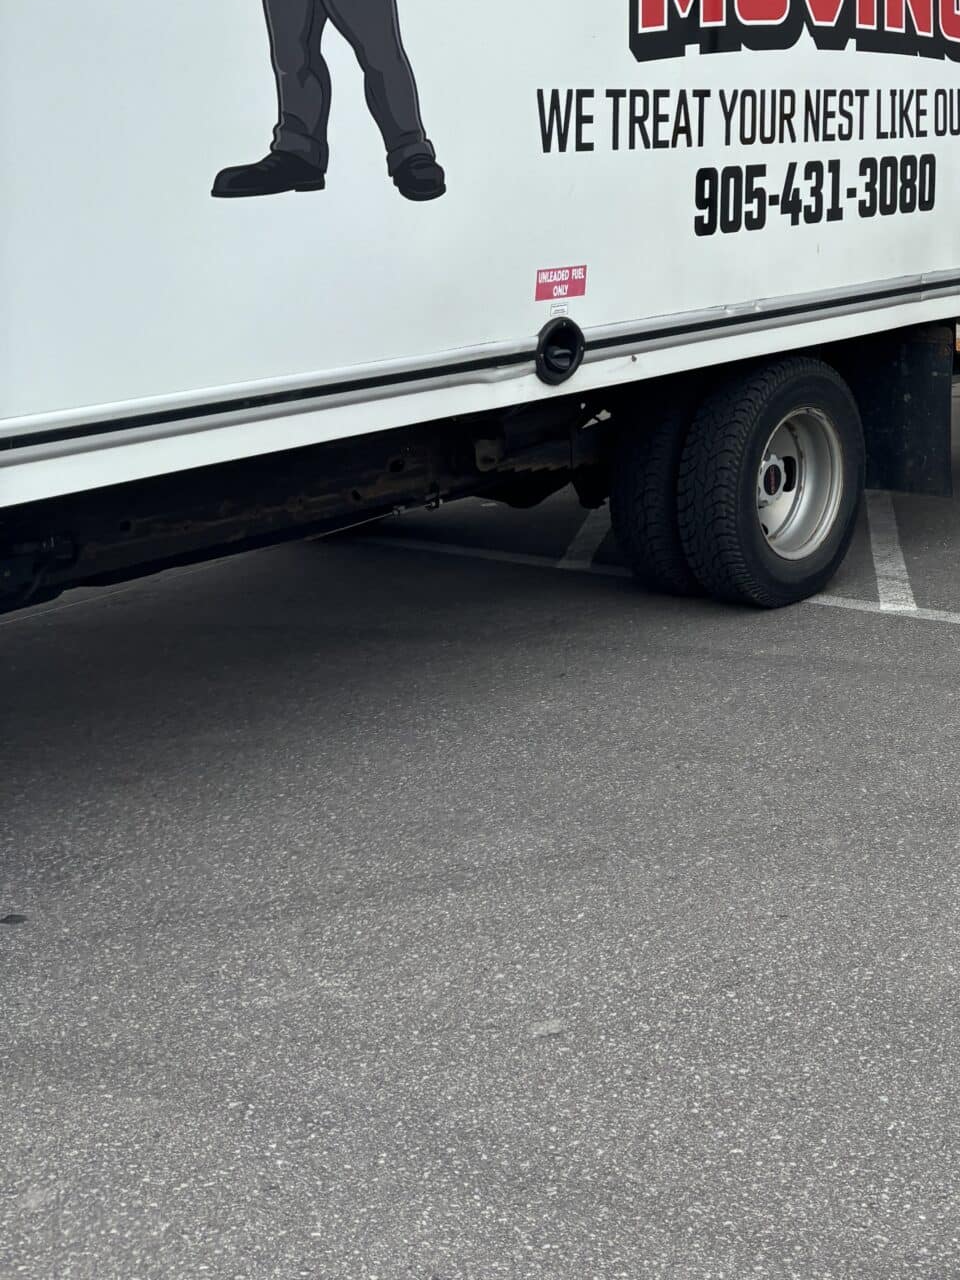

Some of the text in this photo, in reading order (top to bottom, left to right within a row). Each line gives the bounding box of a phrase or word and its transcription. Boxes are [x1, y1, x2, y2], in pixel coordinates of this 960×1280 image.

[537, 88, 595, 154] WE
[605, 88, 712, 151] TREAT
[718, 88, 797, 147] YOUR
[803, 88, 870, 143] NEST
[875, 88, 928, 140] LIKE
[694, 153, 937, 237] 905-431-3080
[538, 267, 585, 284] UNLEADED FUEL
[552, 284, 569, 297] ONLY
